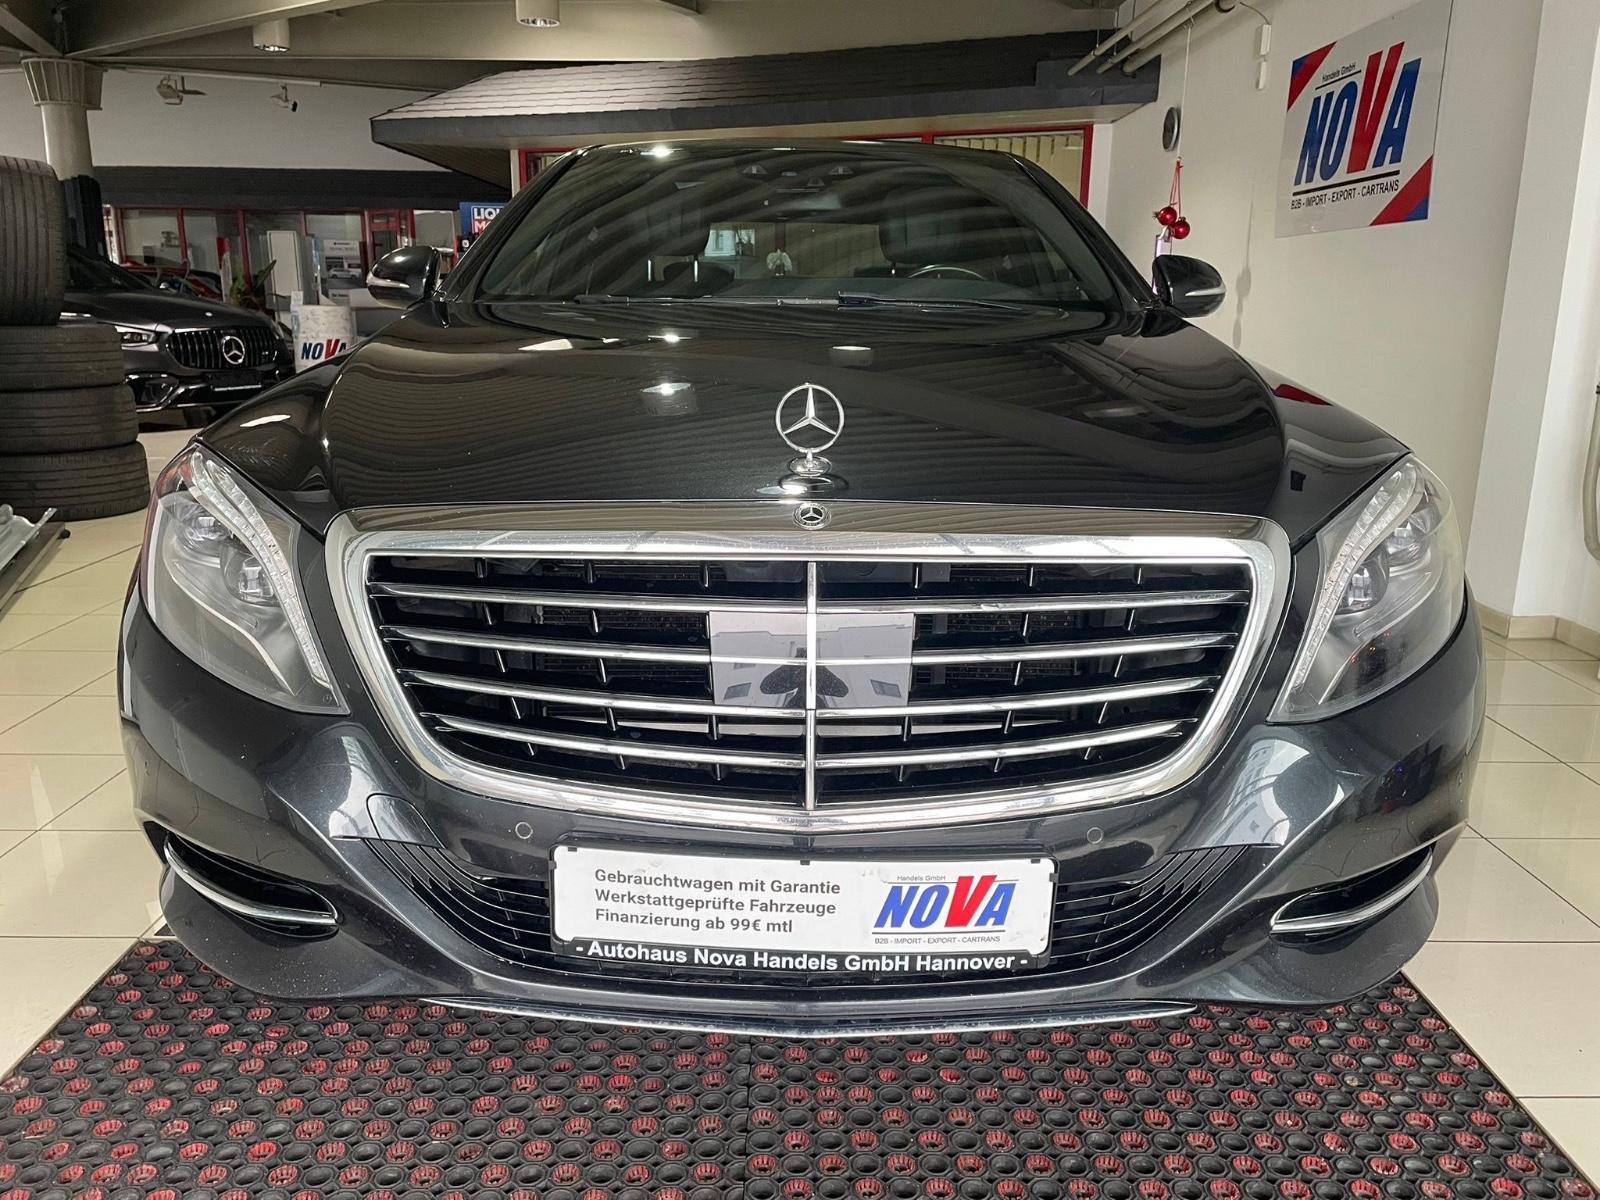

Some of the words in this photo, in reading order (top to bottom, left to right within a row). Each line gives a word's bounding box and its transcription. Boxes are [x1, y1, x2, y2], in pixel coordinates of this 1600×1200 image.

[1341, 62, 1356, 75] GmbH
[1294, 41, 1422, 186] NOVA
[1291, 199, 1301, 209] B2B
[1305, 194, 1327, 207] IMPORT
[1331, 188, 1356, 202] EXPORT
[1361, 180, 1399, 197] CARTRANS
[595, 869, 733, 892] Gebrauchtwagen
[738, 877, 765, 892] mit
[770, 879, 841, 895] Garantie
[595, 888, 745, 911] Werkstattgeprüfte
[750, 898, 836, 917] Fahrzeuge
[874, 875, 1016, 928] NOVA
[595, 908, 700, 931] Finanzierung
[705, 914, 725, 929] ab
[731, 917, 761, 932] 99€
[766, 919, 793, 933] mtl
[961, 935, 1001, 943] CARTRANS
[587, 940, 687, 963] Autohaus
[694, 949, 747, 966] Nova
[753, 952, 838, 971] Handels
[844, 954, 909, 971] GmbH
[916, 954, 1015, 971] Hannover
